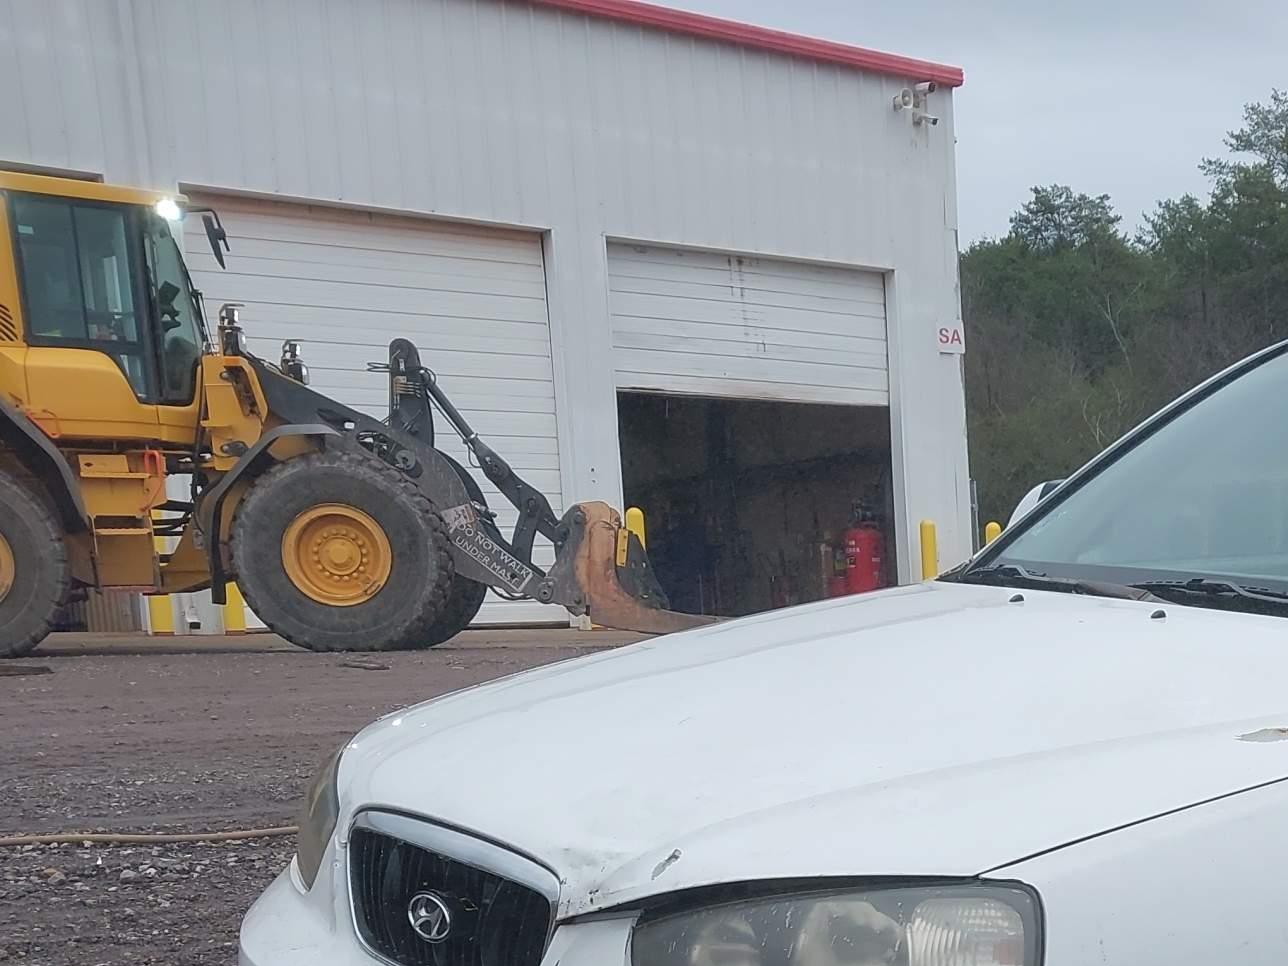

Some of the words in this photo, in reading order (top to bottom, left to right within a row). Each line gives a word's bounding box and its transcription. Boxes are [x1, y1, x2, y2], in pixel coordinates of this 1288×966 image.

[939, 327, 962, 345] SA
[456, 536, 490, 566] UNDER
[457, 522, 474, 537] DO
[474, 535, 499, 554] NOT
[500, 553, 529, 578] WALK
